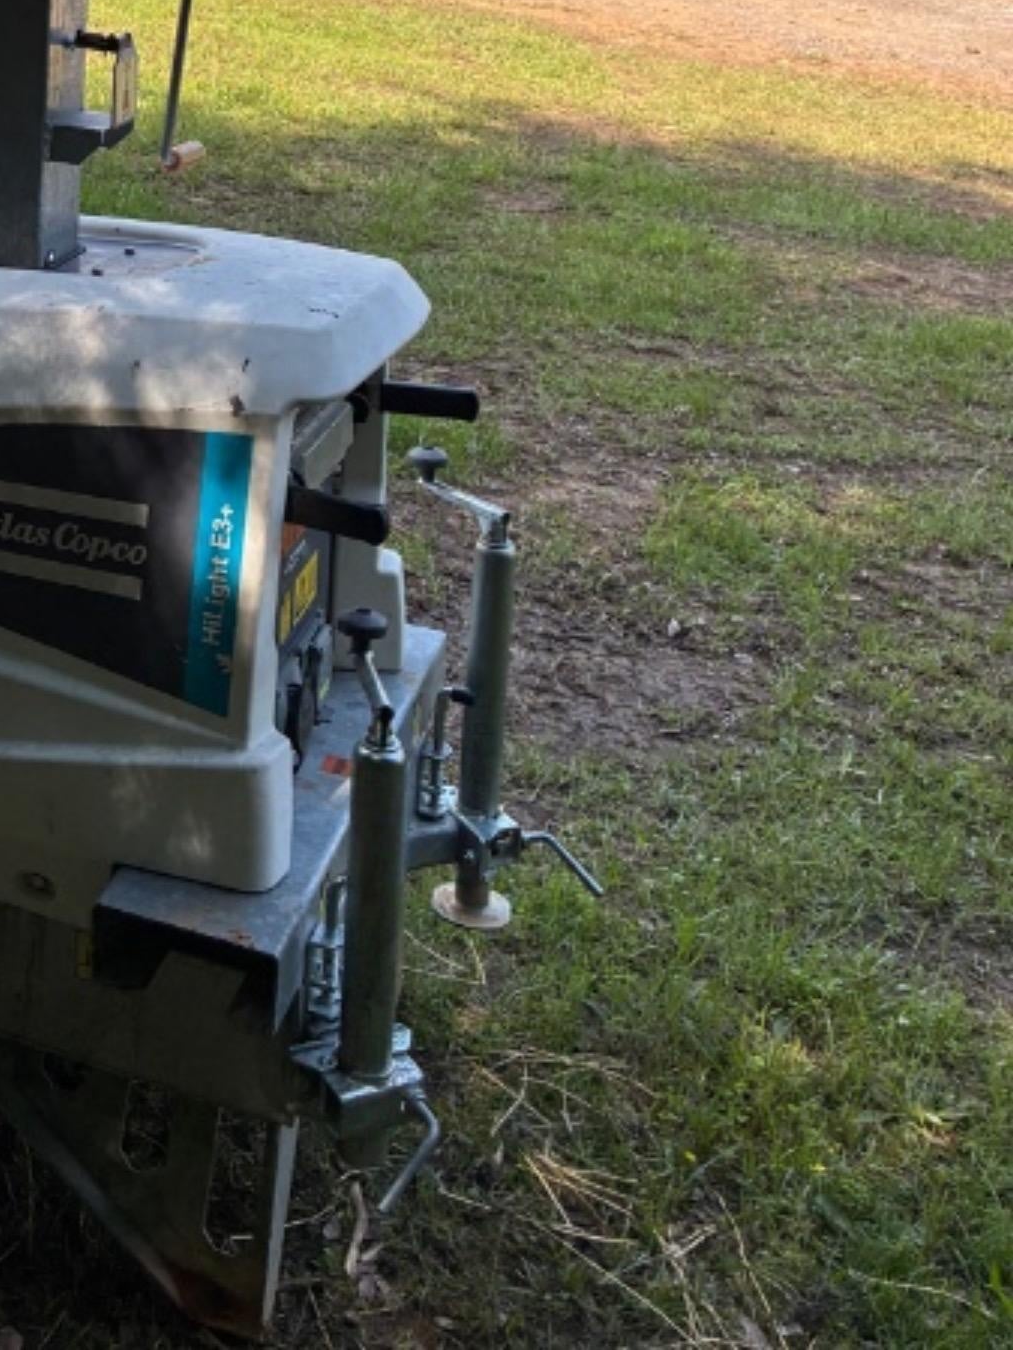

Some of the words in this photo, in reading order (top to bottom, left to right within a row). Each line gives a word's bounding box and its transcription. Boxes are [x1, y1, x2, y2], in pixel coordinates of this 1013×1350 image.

[53, 521, 147, 565] Copco
[210, 504, 234, 549] E3+
[202, 555, 230, 645] HiLight
